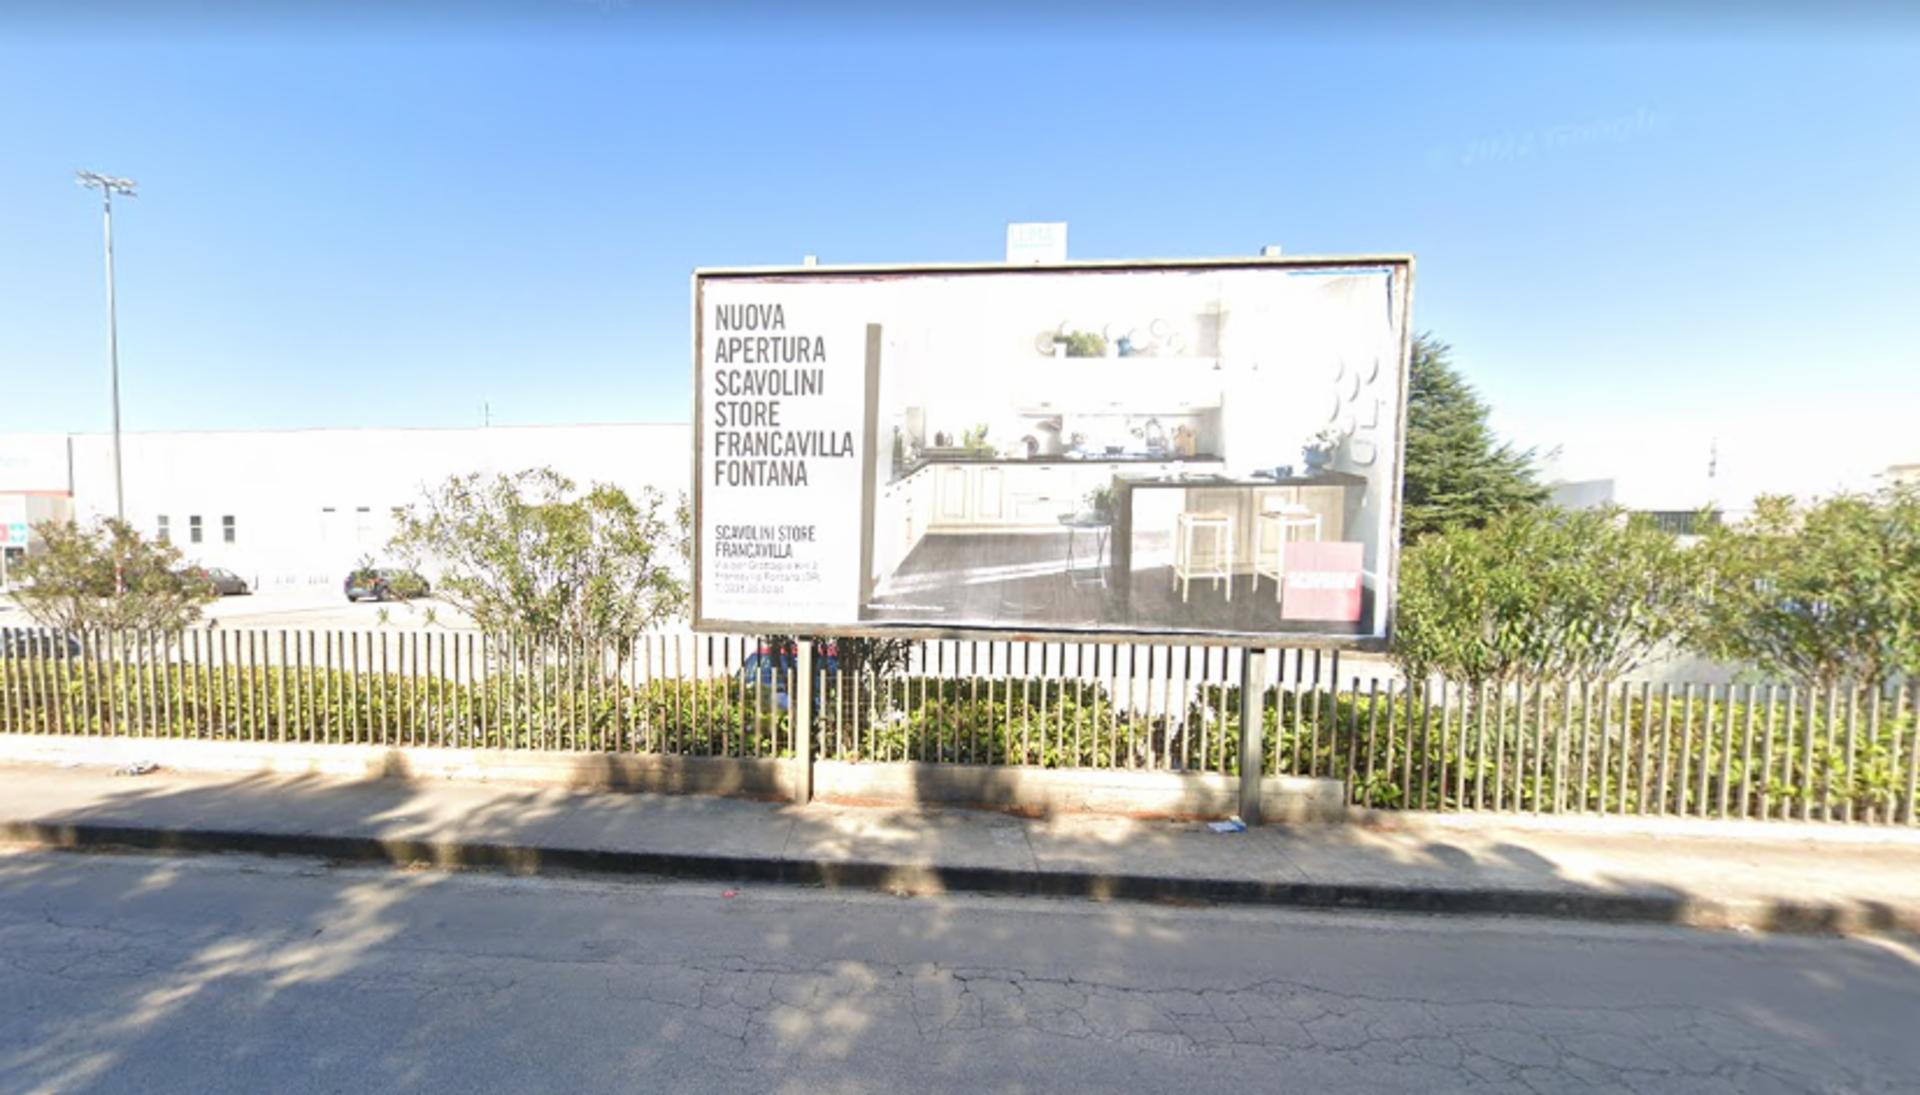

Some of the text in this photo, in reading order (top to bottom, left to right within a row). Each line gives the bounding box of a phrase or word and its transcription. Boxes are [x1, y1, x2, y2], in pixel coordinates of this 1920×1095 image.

[715, 303, 786, 331] NUOVA
[714, 336, 827, 363] APERTURA
[715, 369, 824, 396] SCAVOLINI
[715, 401, 781, 427] STORE
[715, 431, 855, 458] FRANCAVILLA
[715, 460, 808, 487] FONTANA
[715, 525, 816, 542] SCAVOLINI STORE
[715, 542, 793, 559] FRANCAVILLA
